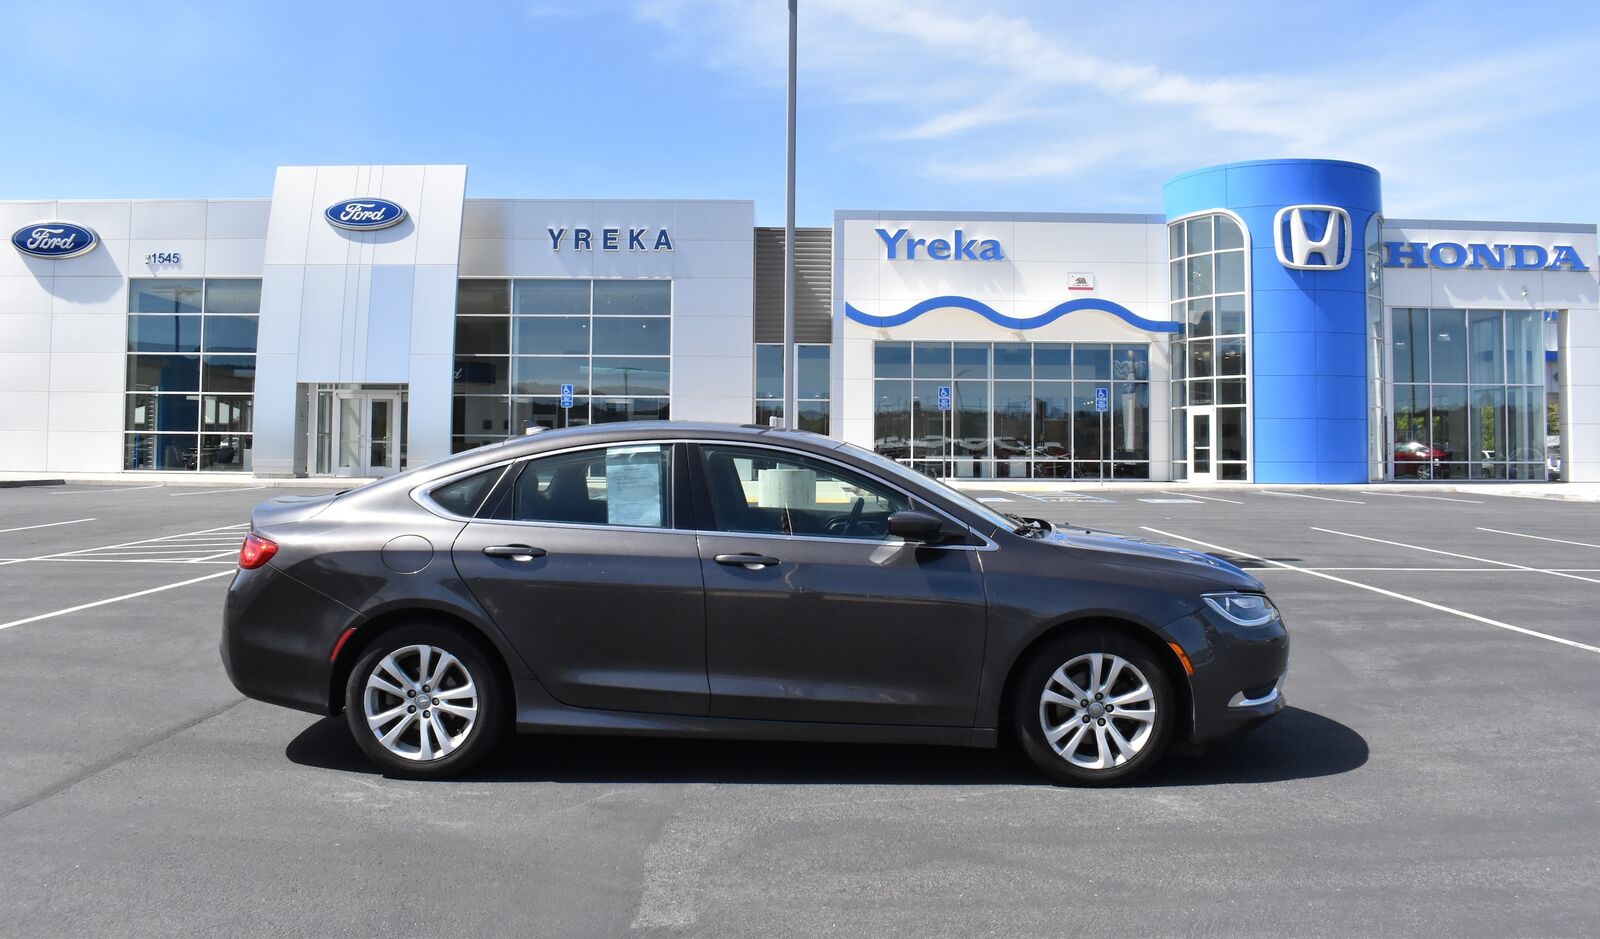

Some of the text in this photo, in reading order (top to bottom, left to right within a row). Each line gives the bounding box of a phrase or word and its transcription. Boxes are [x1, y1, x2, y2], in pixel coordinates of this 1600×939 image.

[340, 203, 386, 221] Ford
[27, 227, 76, 249] Ford
[547, 228, 674, 251] YREKA
[875, 228, 1005, 261] Yreka
[152, 252, 180, 264] 1545
[1383, 241, 1590, 271] HONDA
